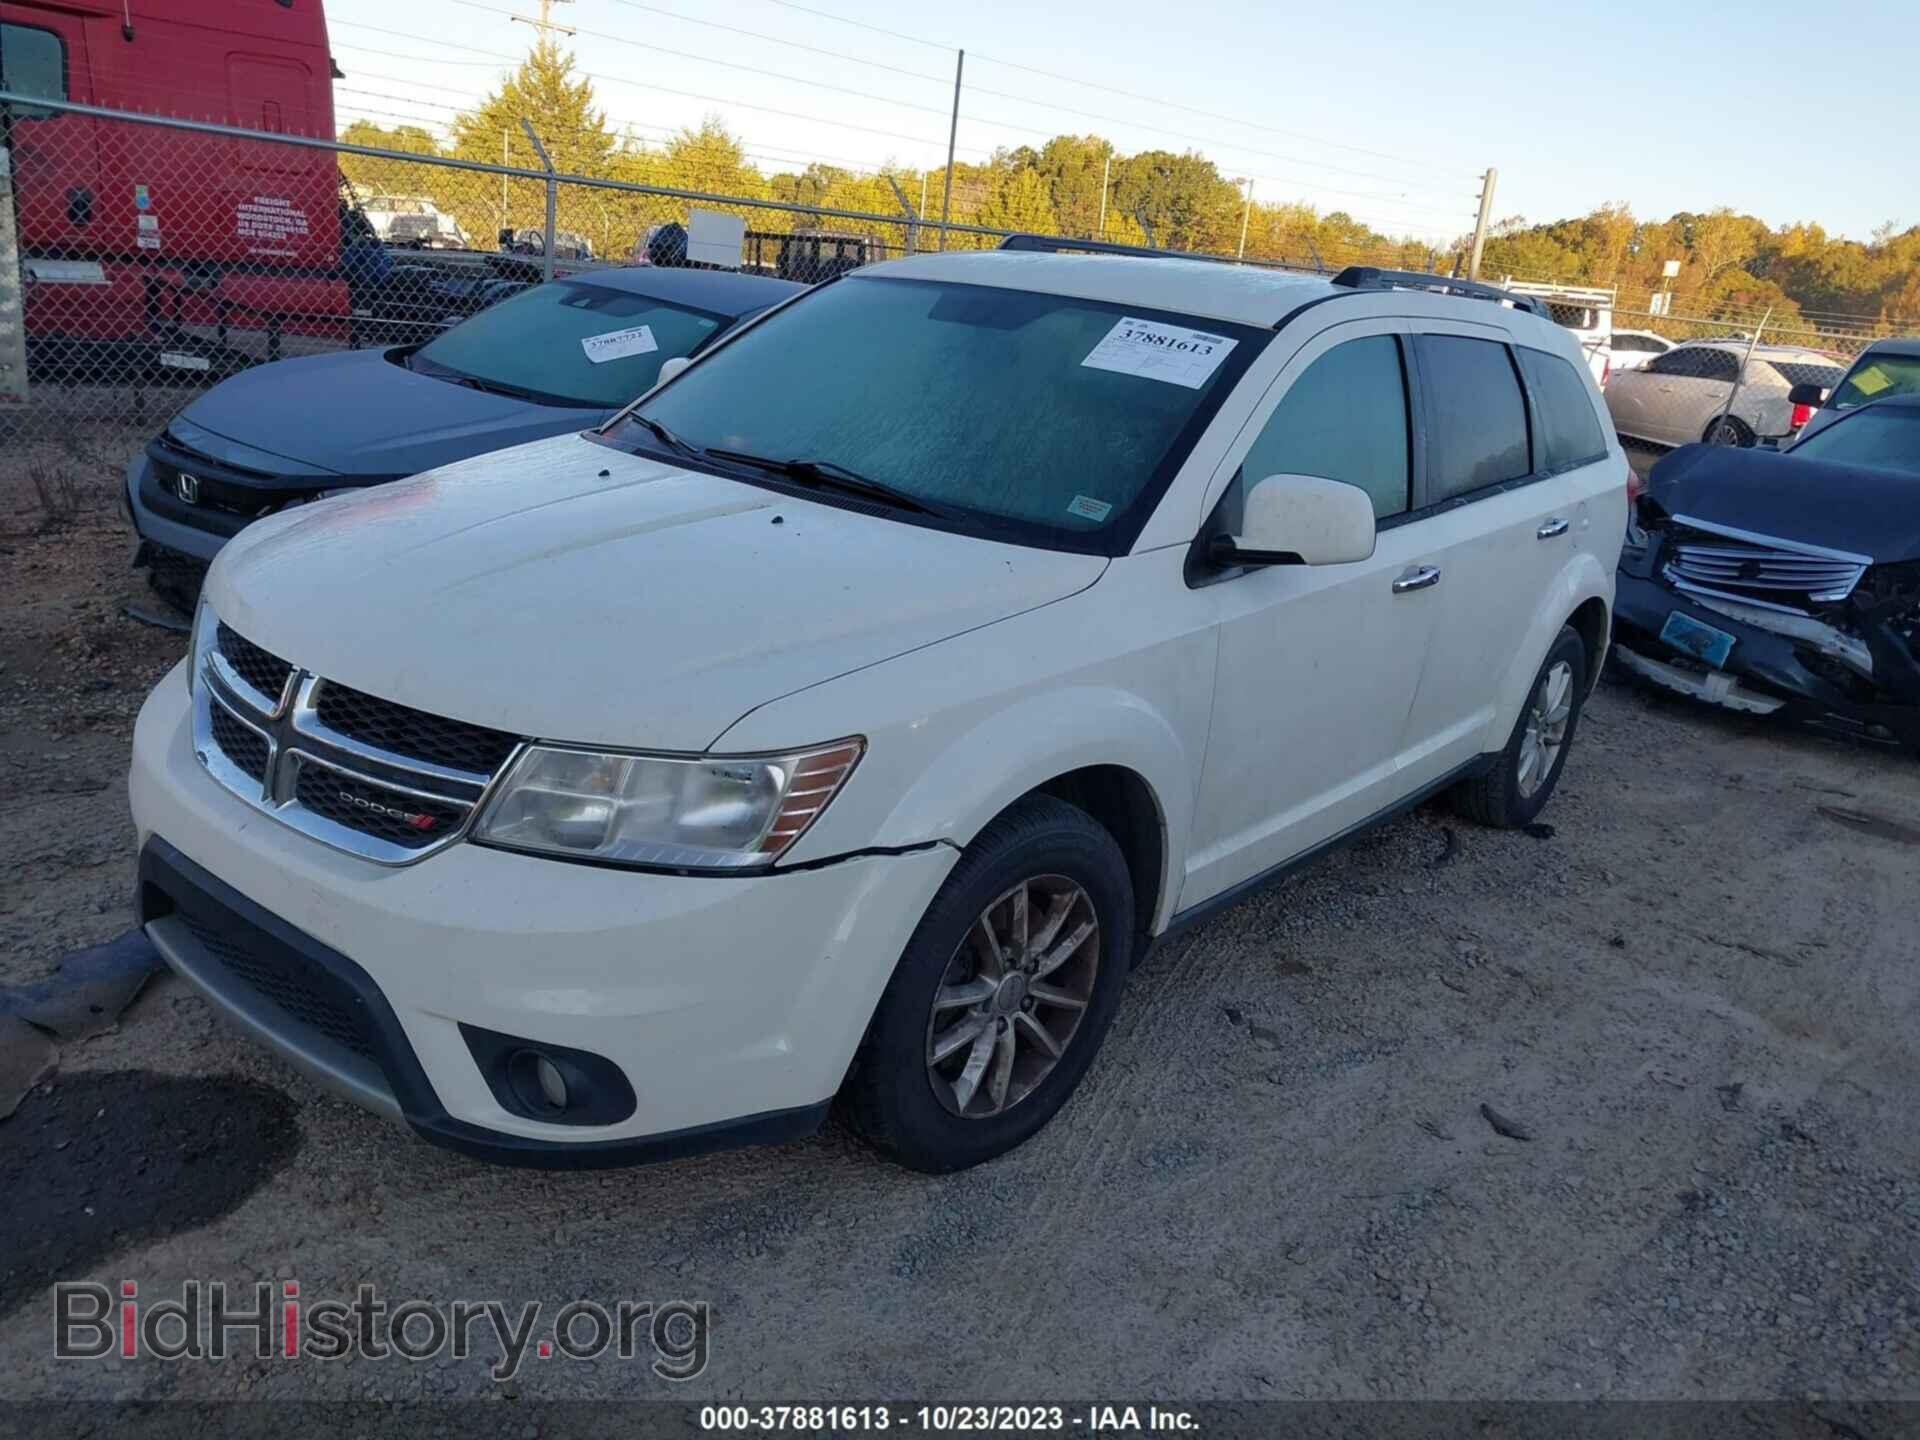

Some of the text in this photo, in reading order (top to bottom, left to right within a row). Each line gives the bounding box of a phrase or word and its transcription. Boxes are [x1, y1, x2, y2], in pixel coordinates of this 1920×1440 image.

[238, 203, 305, 218] INTERNATIONAL
[1119, 328, 1213, 356] 37881613
[339, 791, 418, 822] DODGE
